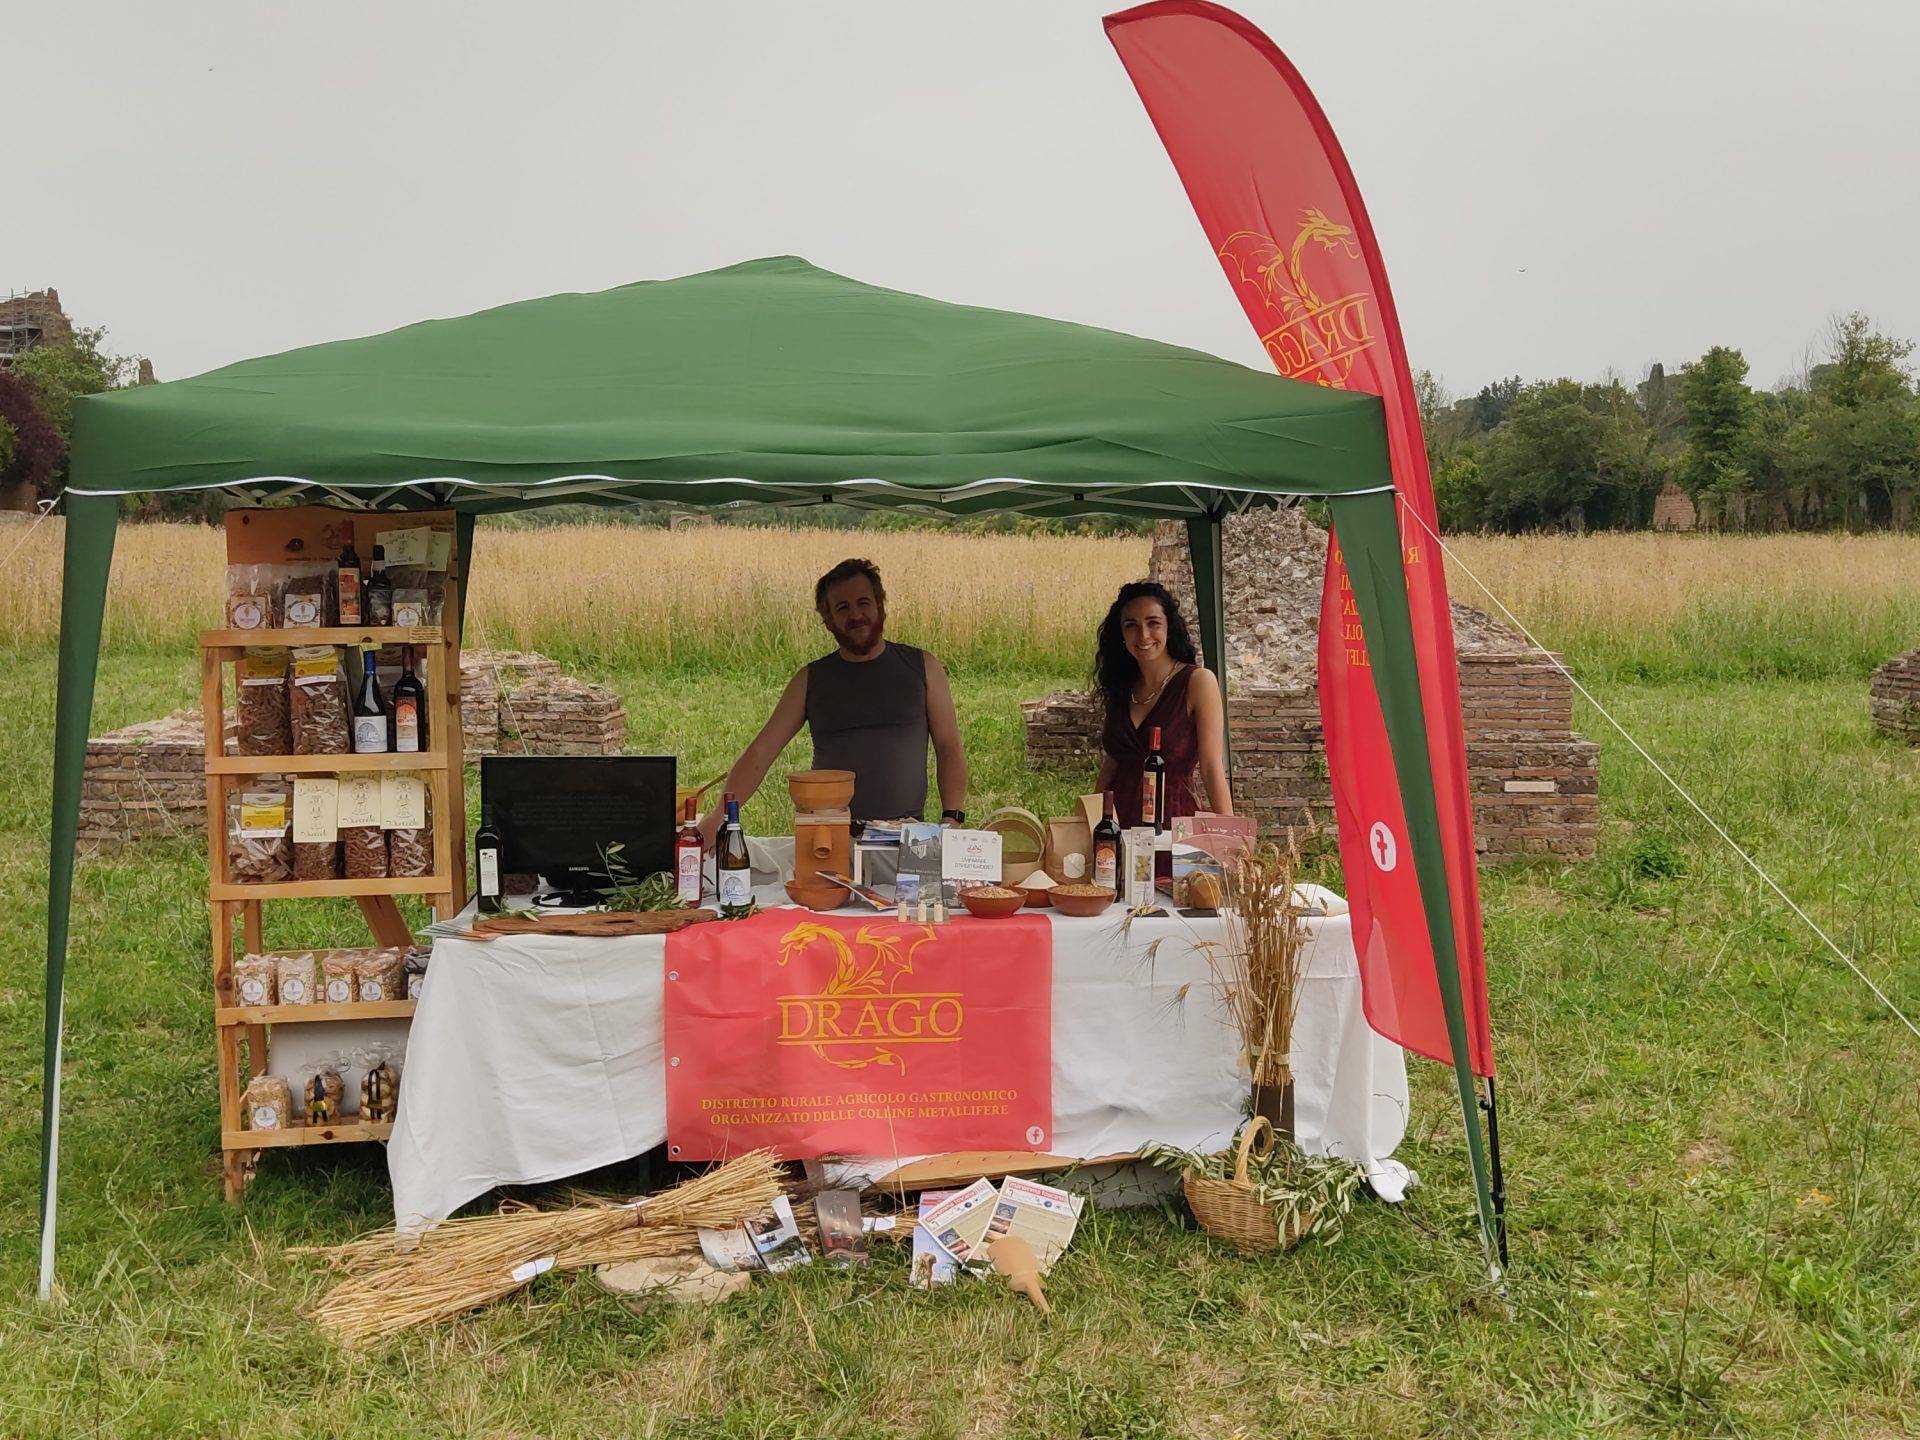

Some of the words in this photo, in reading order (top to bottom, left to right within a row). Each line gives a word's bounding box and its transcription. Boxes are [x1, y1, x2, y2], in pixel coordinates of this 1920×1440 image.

[776, 997, 965, 1039] DRAGO
[702, 1097, 778, 1110] DISTRETTO
[781, 1095, 833, 1108] RURALE
[835, 1092, 906, 1105] AGRICOLO
[909, 1089, 1018, 1103] GASTRONOMICO
[710, 1111, 810, 1125] ORGANIZZATO
[813, 1109, 855, 1121] DELLE
[858, 1107, 915, 1119] COLLINE
[918, 1105, 1009, 1118] METALLIFERE
